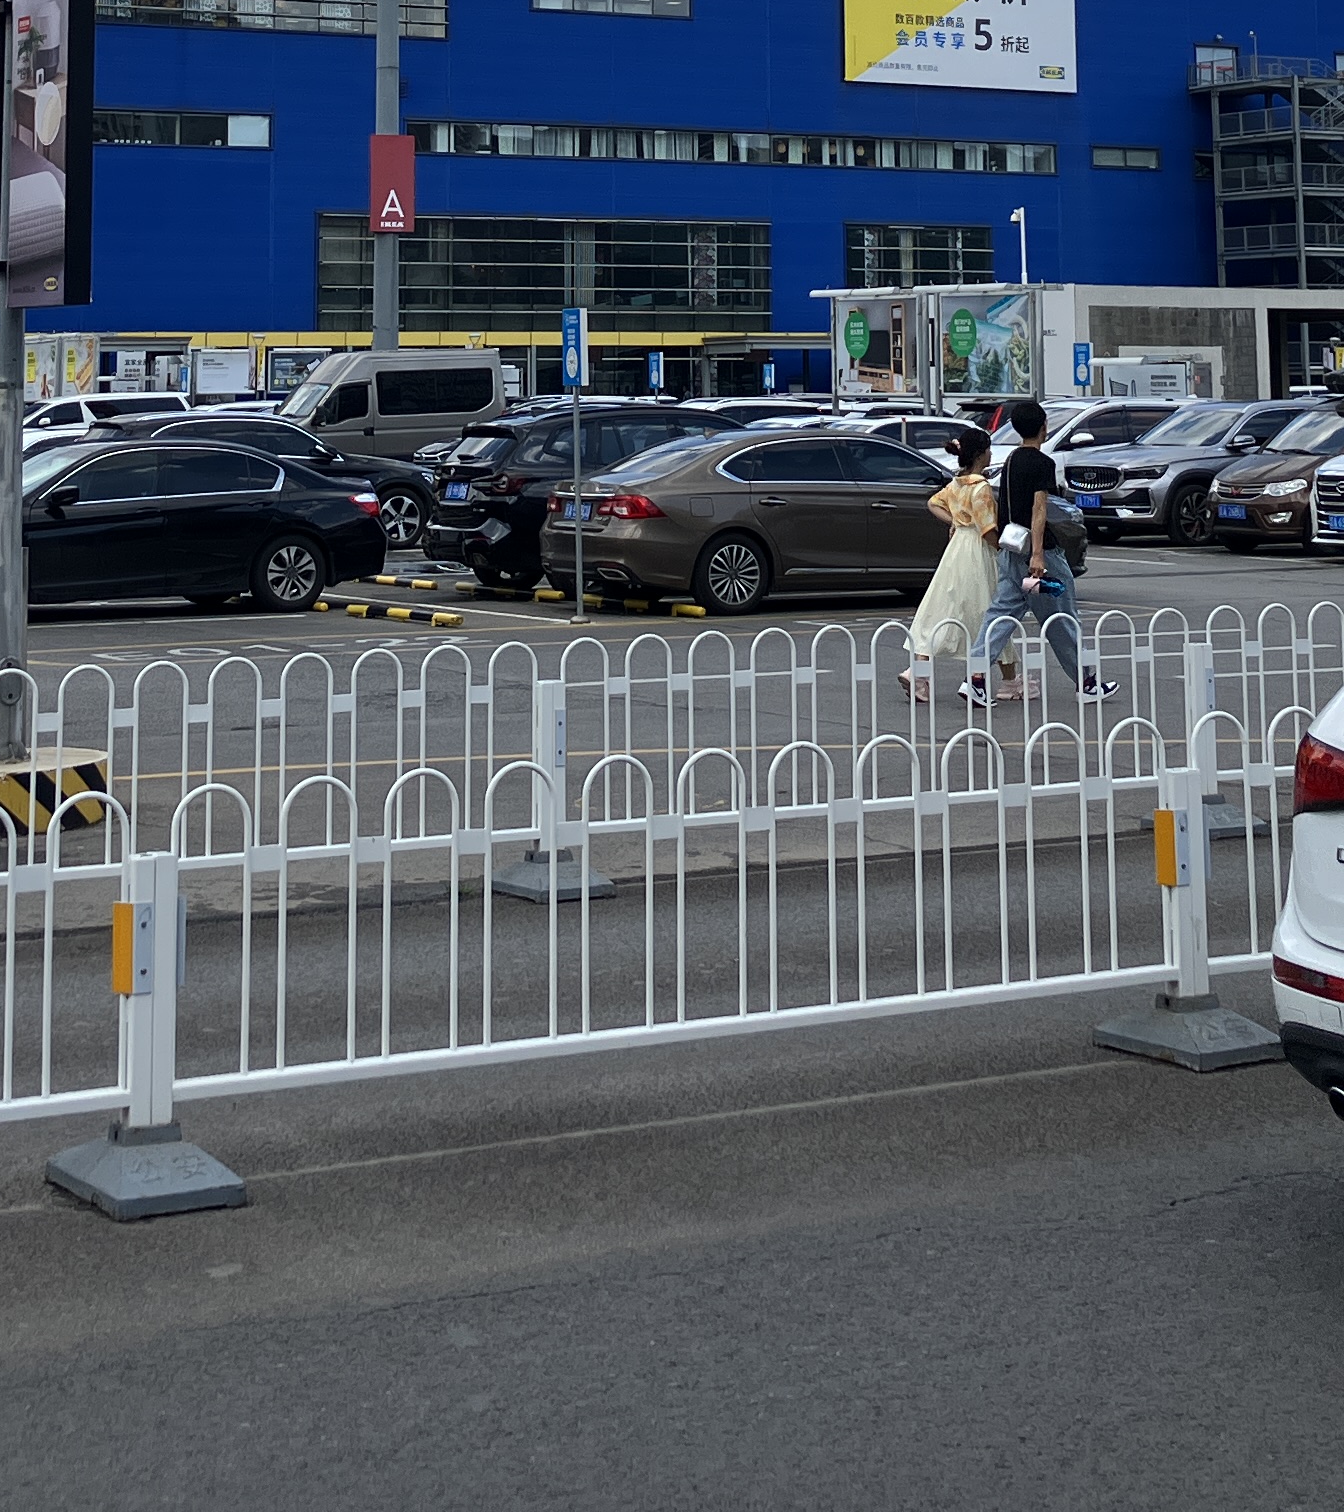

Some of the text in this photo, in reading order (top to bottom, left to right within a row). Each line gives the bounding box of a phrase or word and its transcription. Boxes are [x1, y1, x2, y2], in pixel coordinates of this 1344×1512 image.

[895, 13, 965, 29] 数百款精选商品
[895, 29, 966, 50] 会员专享
[974, 18, 993, 51] 5
[381, 189, 404, 217] A
